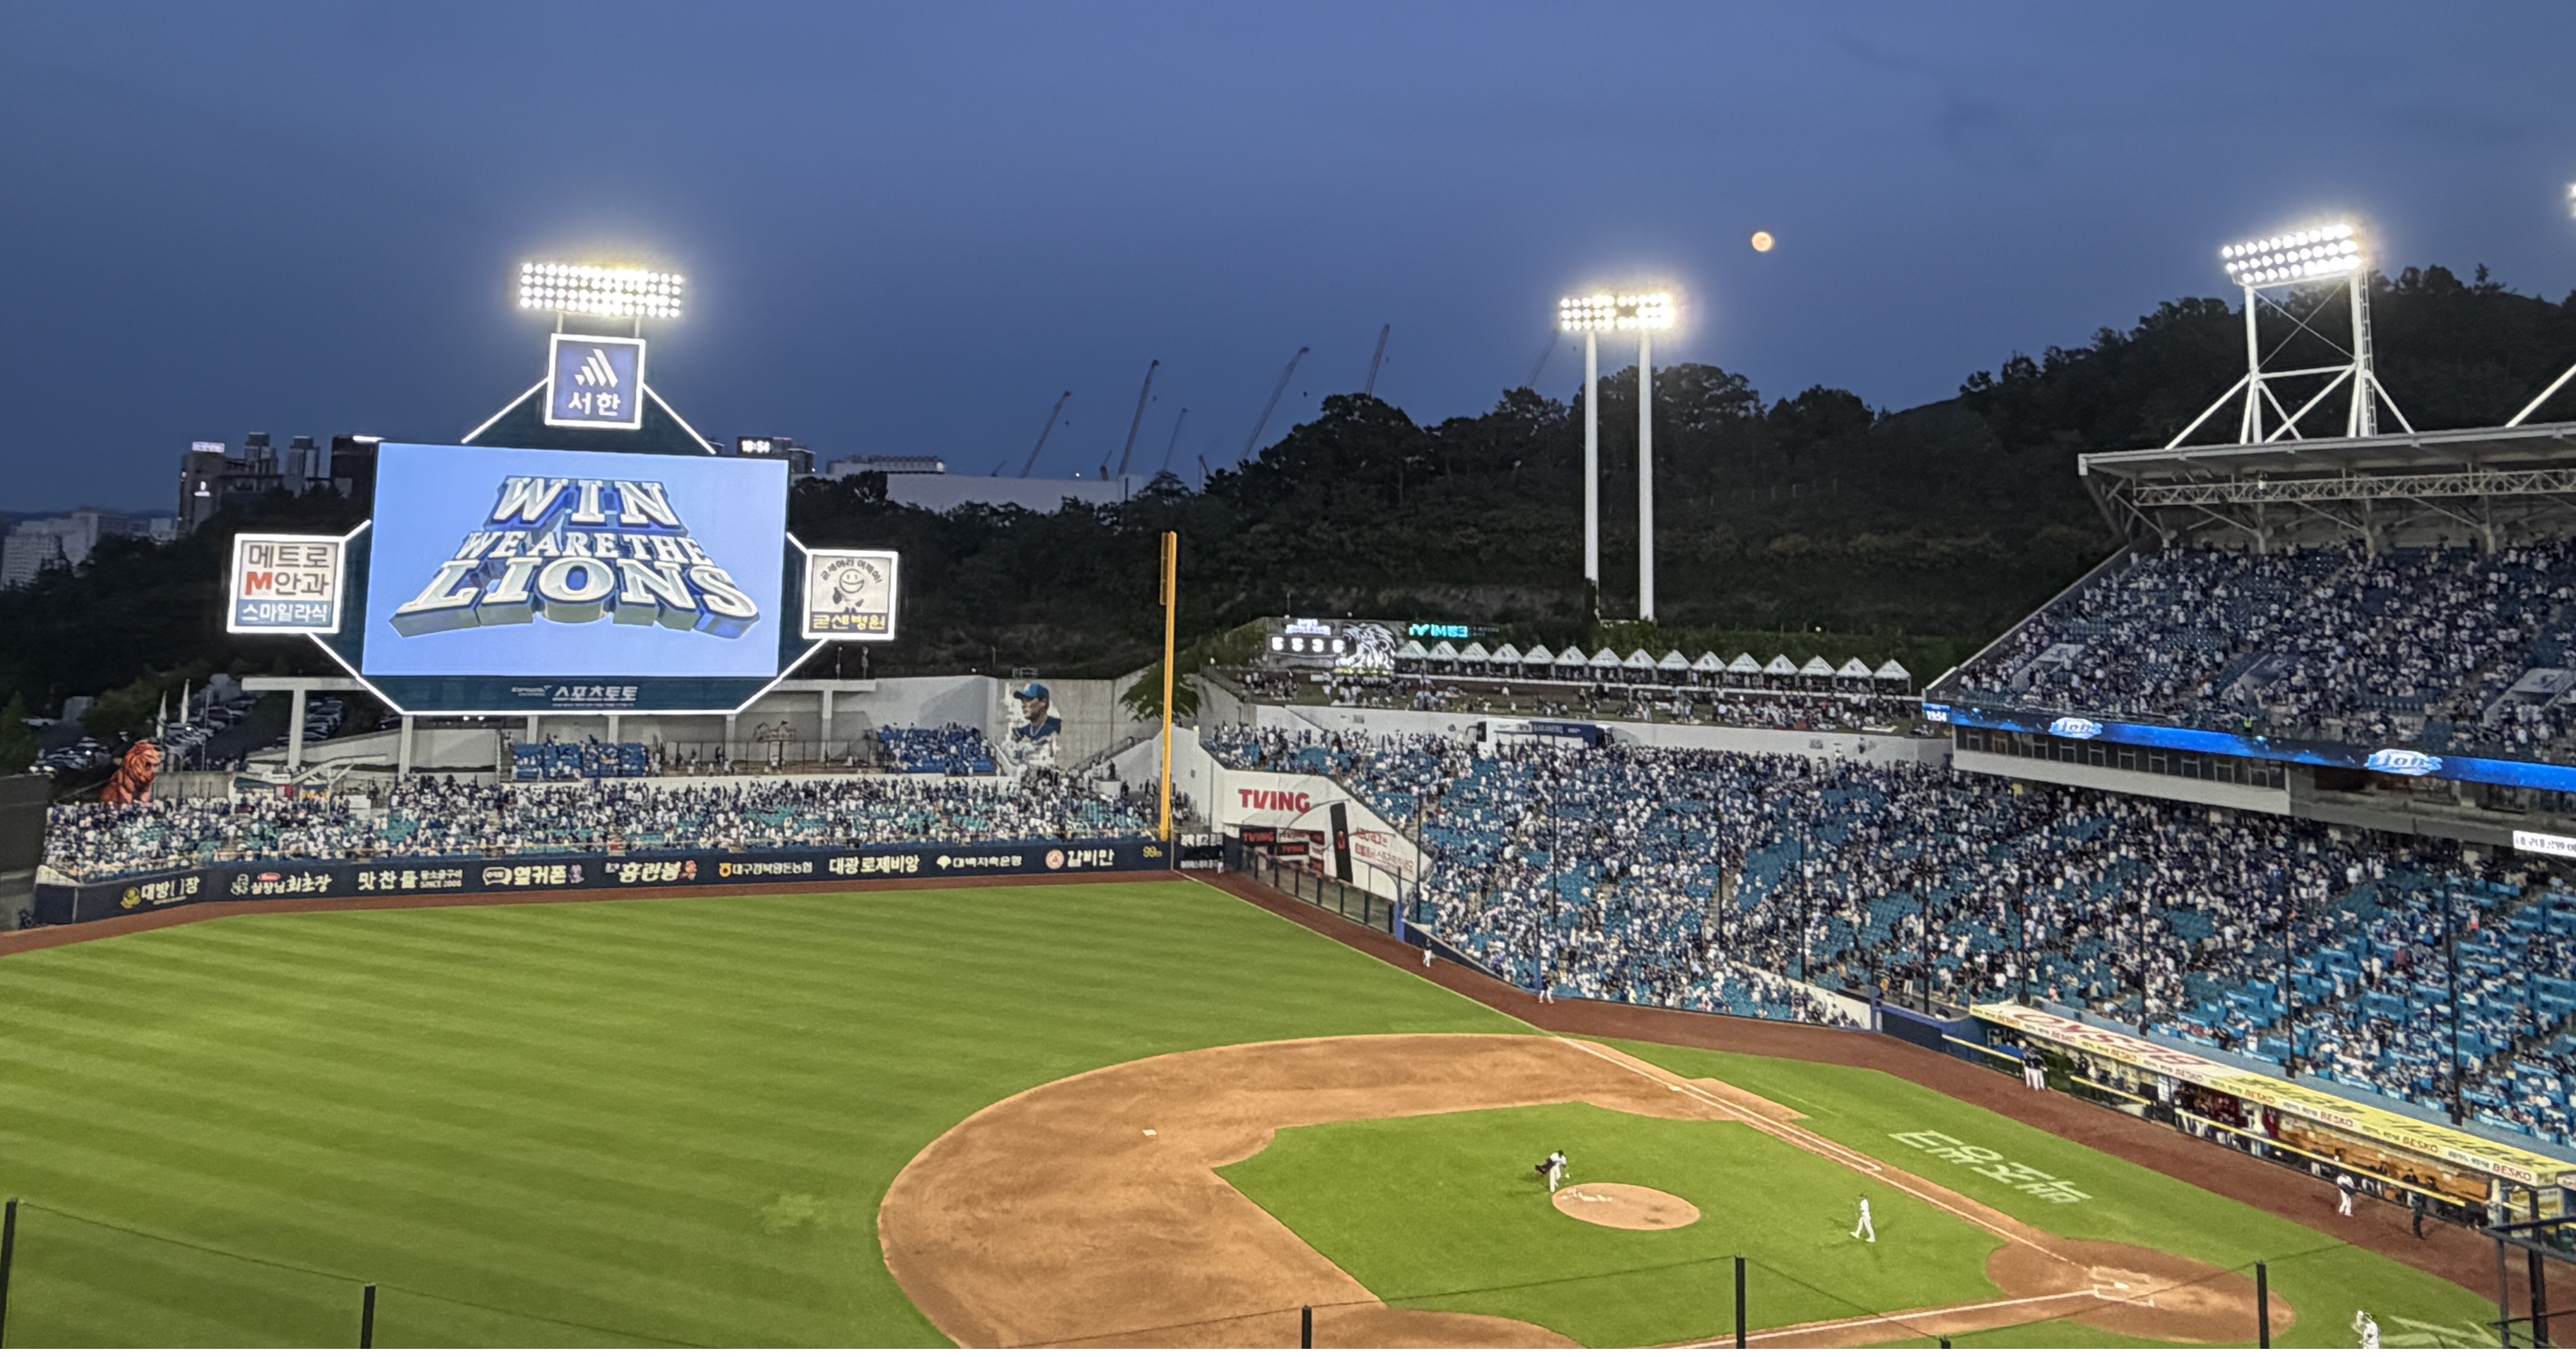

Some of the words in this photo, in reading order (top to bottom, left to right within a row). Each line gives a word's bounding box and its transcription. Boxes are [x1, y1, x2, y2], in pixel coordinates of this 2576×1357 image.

[569, 392, 621, 417] 서한
[492, 477, 680, 525] WIN
[248, 545, 330, 568] 메트로
[454, 531, 527, 559] WE
[528, 531, 620, 558] ARE
[623, 535, 718, 566] THE
[245, 571, 330, 596] M안과
[396, 557, 759, 618] LIONS
[241, 603, 328, 622] 스마일라식
[552, 685, 638, 701] 스포츠토토
[1237, 788, 1311, 813] TVING
[2493, 1163, 2532, 1181] BESKO
